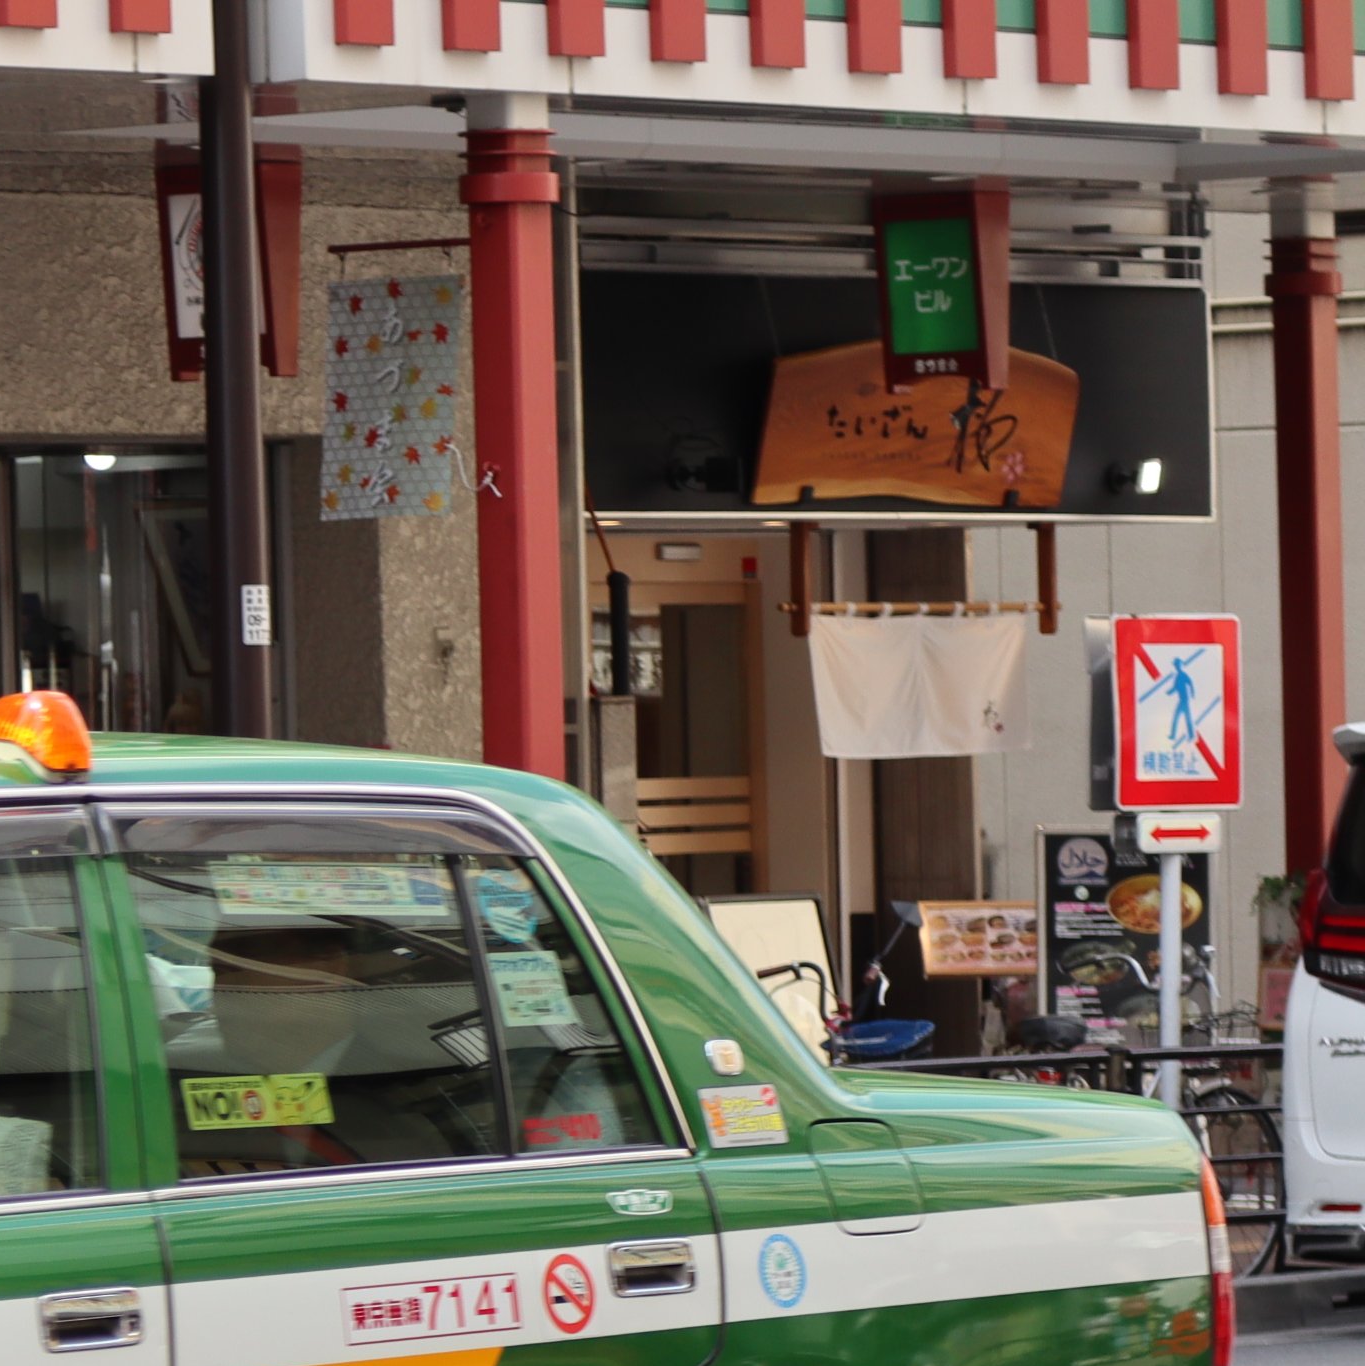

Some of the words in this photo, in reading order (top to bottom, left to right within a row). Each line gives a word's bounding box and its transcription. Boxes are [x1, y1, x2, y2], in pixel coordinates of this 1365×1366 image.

[894, 257, 968, 281] エーワン
[915, 289, 952, 313] ビル
[1143, 750, 1200, 775] 横断禁止
[188, 1089, 242, 1121] NO!
[352, 1297, 421, 1331] 東京無線
[422, 1278, 521, 1330] 7141
